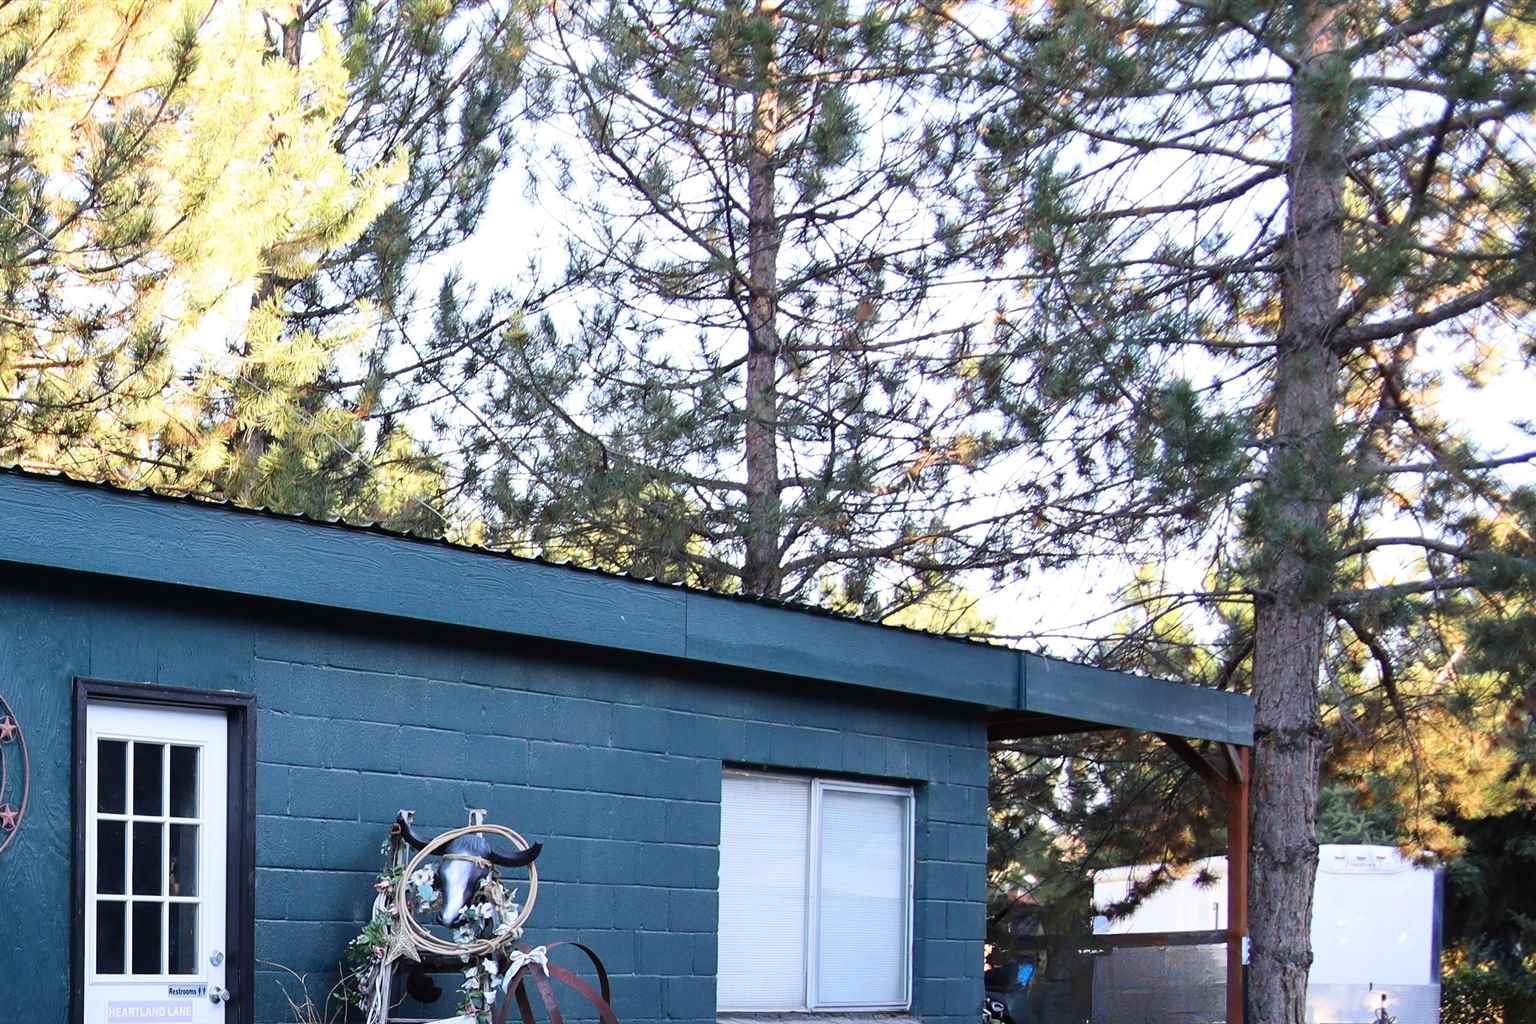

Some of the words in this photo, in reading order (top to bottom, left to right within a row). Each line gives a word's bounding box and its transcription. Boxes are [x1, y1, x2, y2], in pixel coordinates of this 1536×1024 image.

[168, 987, 197, 996] Restrooms
[108, 1006, 166, 1017] HEARTLAND
[167, 1006, 193, 1017] LANE
